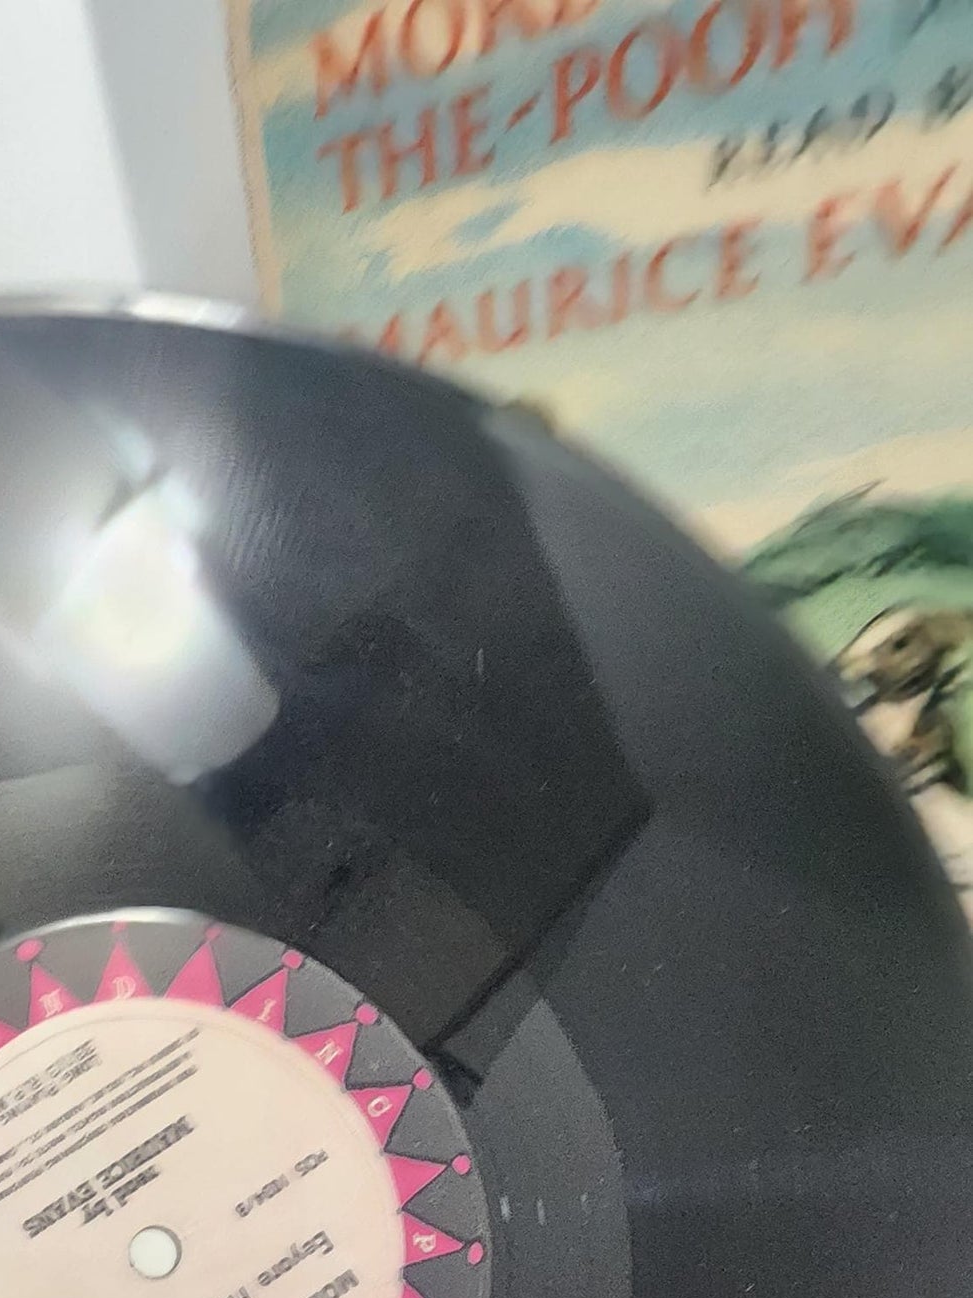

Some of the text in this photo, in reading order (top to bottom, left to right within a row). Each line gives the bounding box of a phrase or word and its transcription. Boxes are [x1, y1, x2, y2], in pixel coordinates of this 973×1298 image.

[313, 0, 599, 121] MOR
[23, 1180, 98, 1239] EVANS
[81, 1196, 114, 1225] by
[257, 1231, 334, 1287] Eeyore
